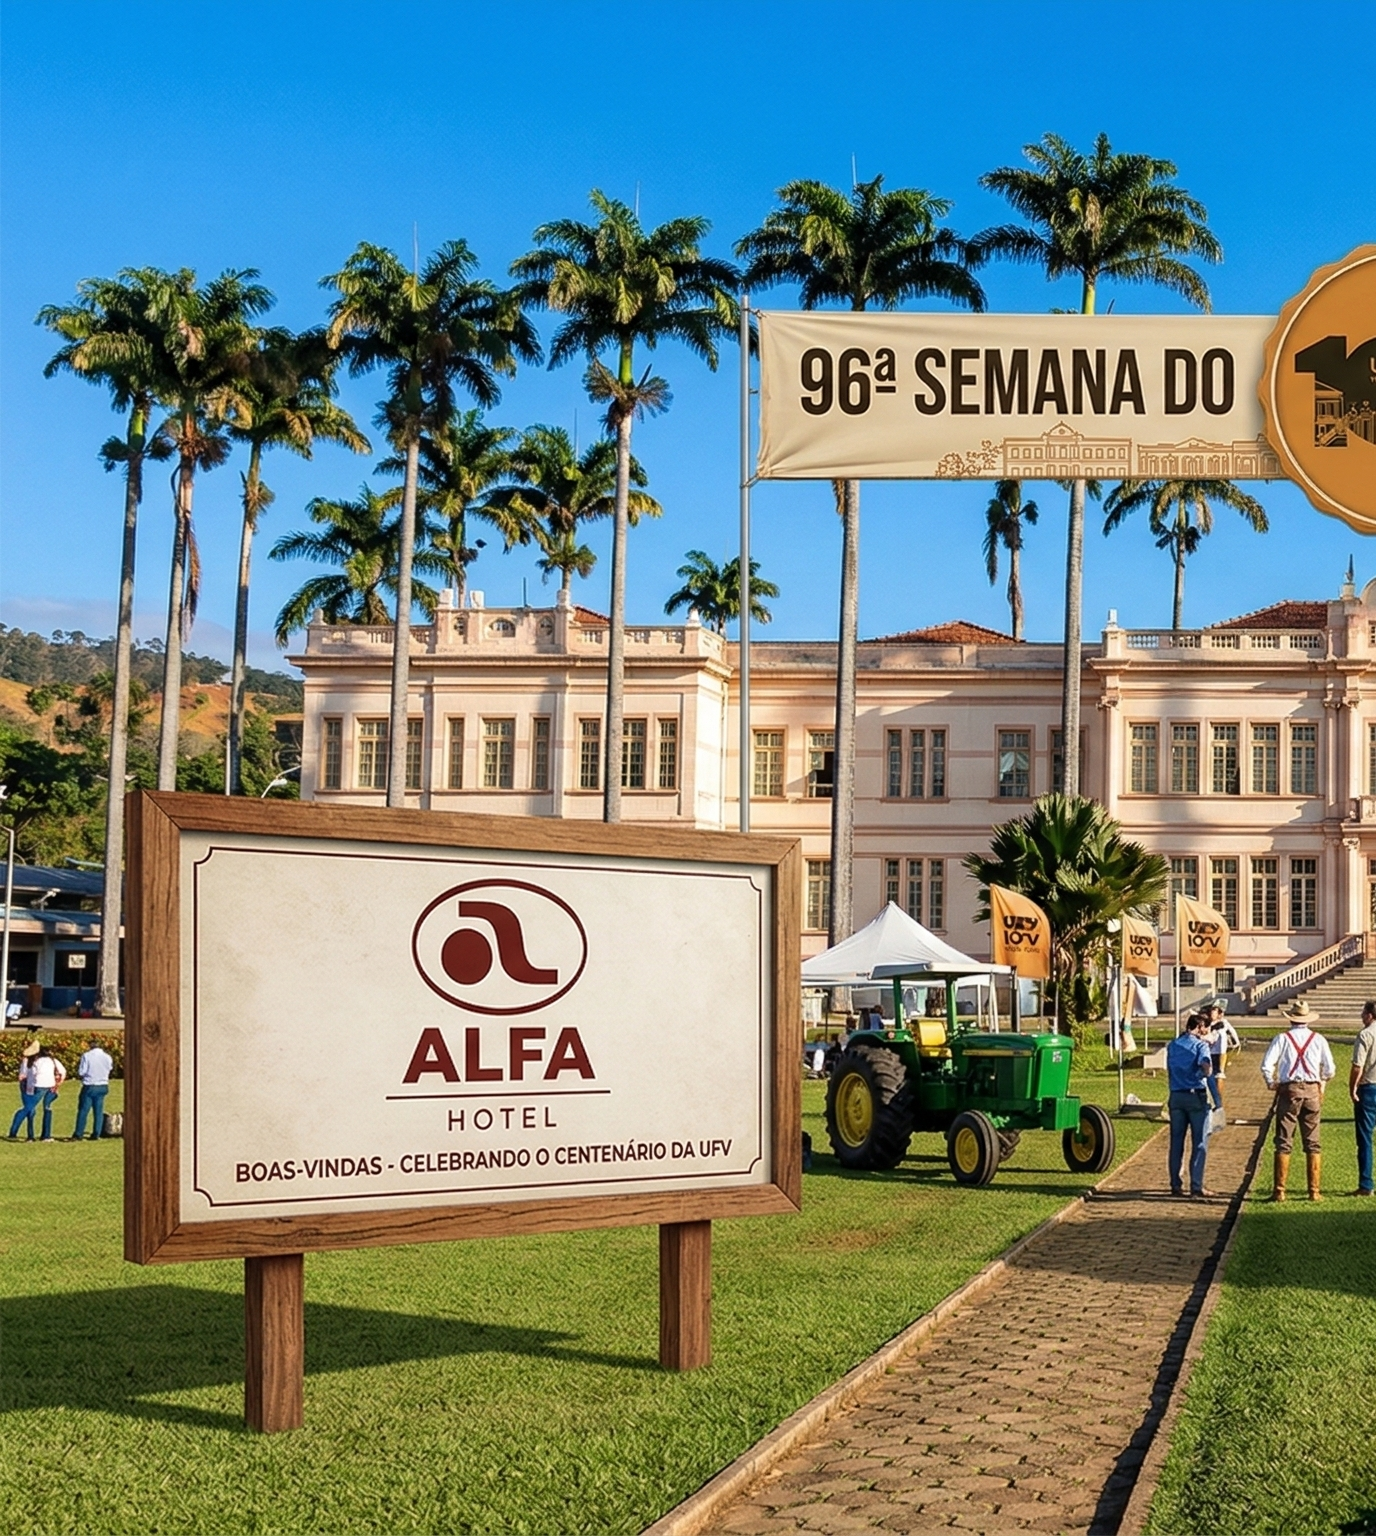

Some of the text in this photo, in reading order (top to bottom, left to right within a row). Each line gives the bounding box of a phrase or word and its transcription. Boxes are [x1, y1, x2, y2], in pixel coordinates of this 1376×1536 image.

[801, 347, 1235, 416] 96ª SEMANA DO
[402, 1026, 596, 1084] ALFA
[448, 1106, 557, 1132] HOTEL
[236, 1156, 383, 1183] BOAS-VINDAS
[399, 1148, 531, 1174] CELEBRANDO
[535, 1147, 550, 1166] O
[554, 1138, 667, 1165] CENTENÁRIO
[671, 1141, 696, 1159] DA
[699, 1139, 733, 1158] UFV
